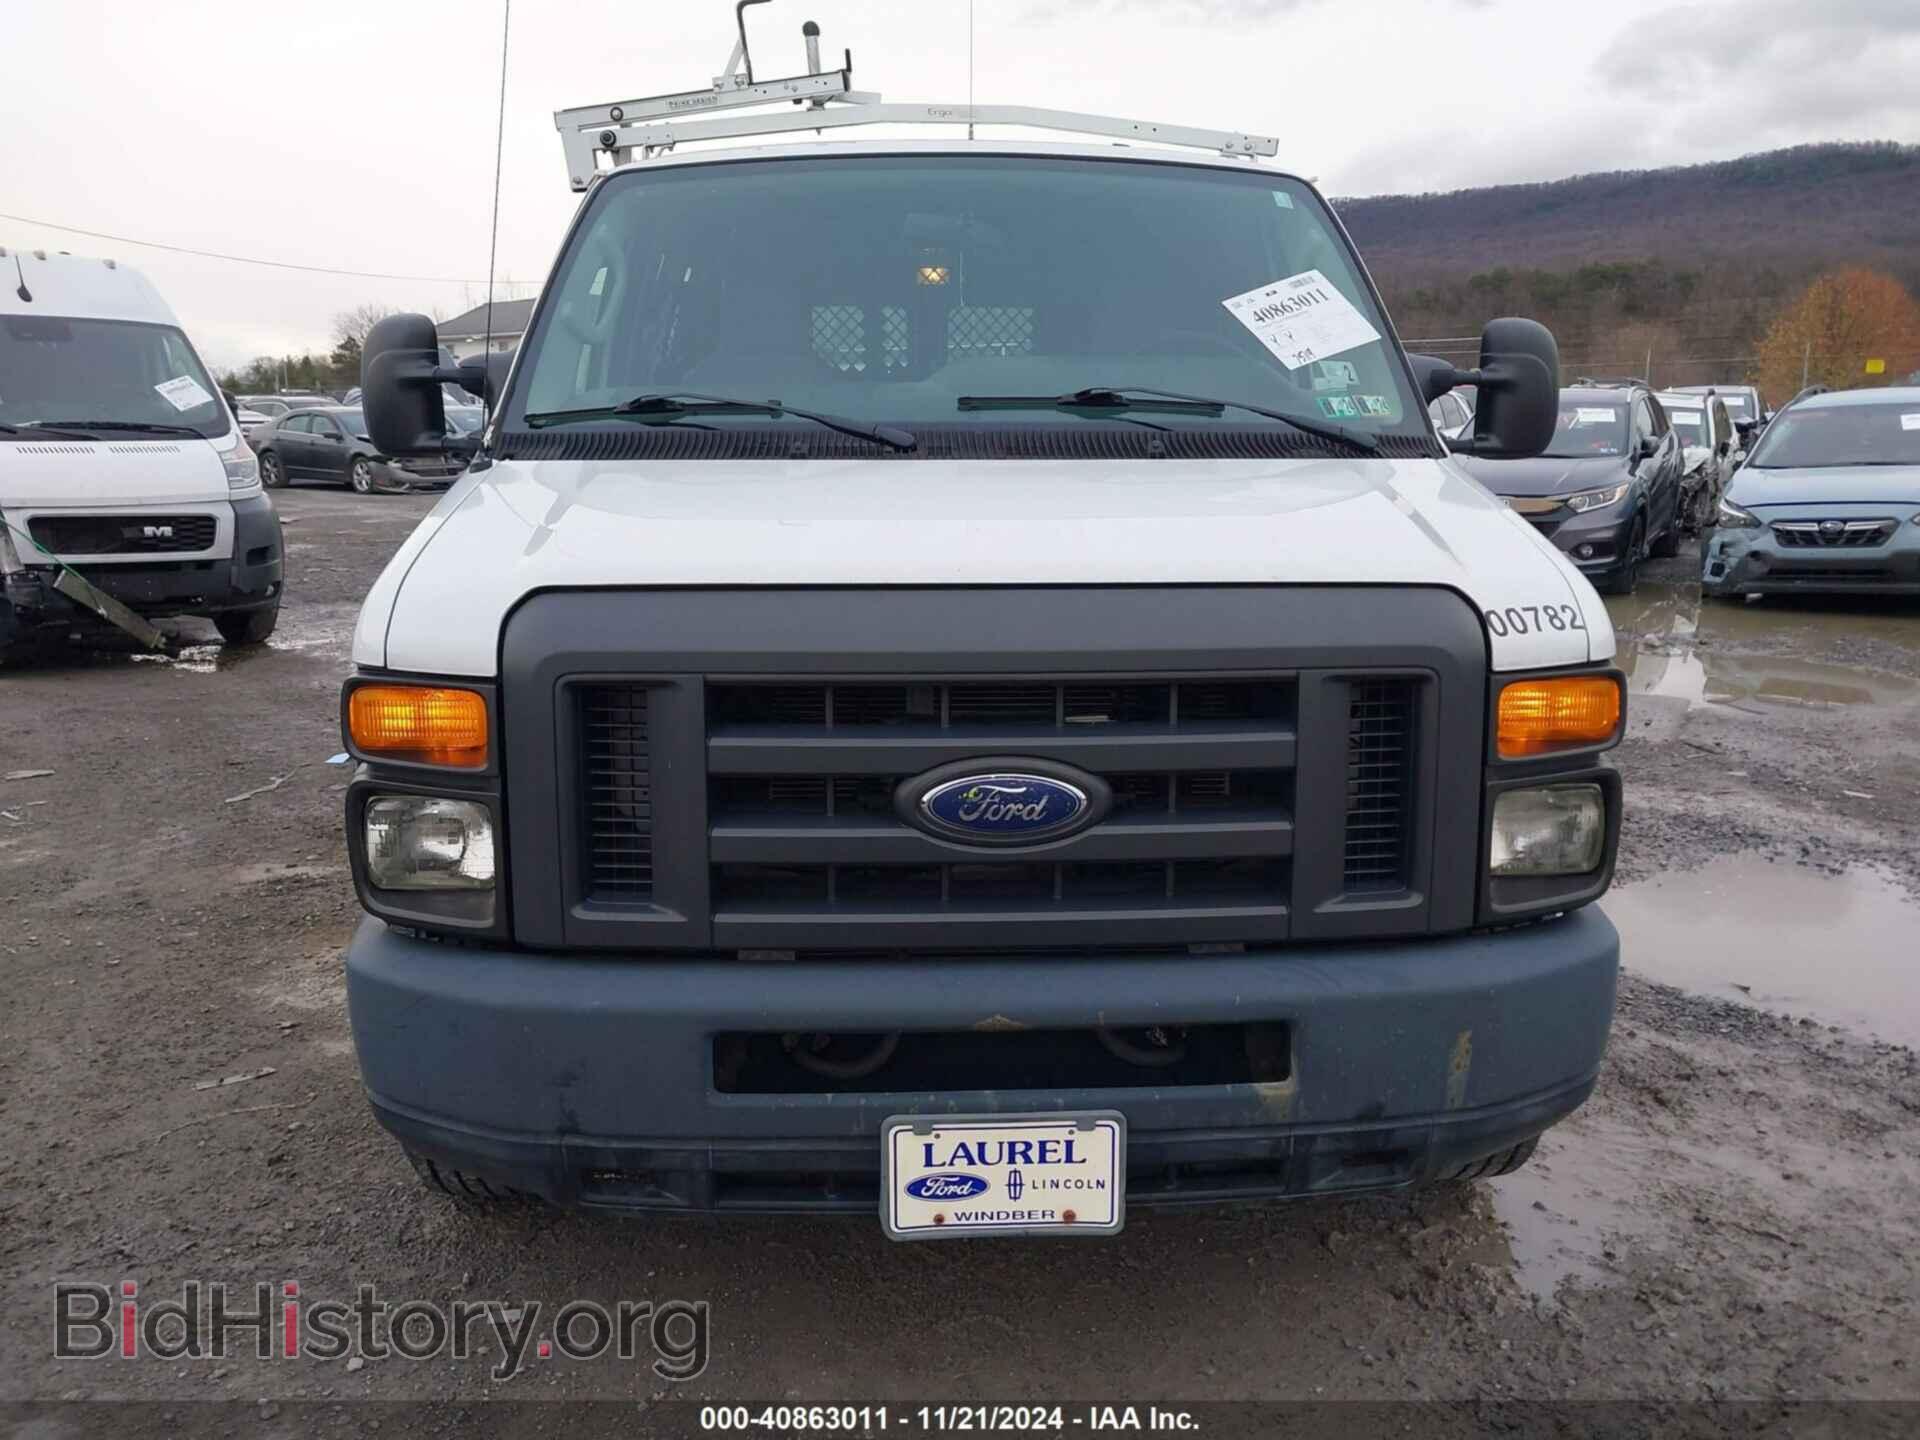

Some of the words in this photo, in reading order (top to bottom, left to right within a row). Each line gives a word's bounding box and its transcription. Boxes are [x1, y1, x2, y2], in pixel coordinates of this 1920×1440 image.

[1252, 287, 1329, 323] 40863011
[1485, 604, 1586, 637] 00782
[958, 784, 1050, 822] Ford
[922, 1139, 1087, 1168] LAUREL
[1031, 1178, 1106, 1190] LINCOLN
[953, 1209, 1056, 1222] WINDBER
